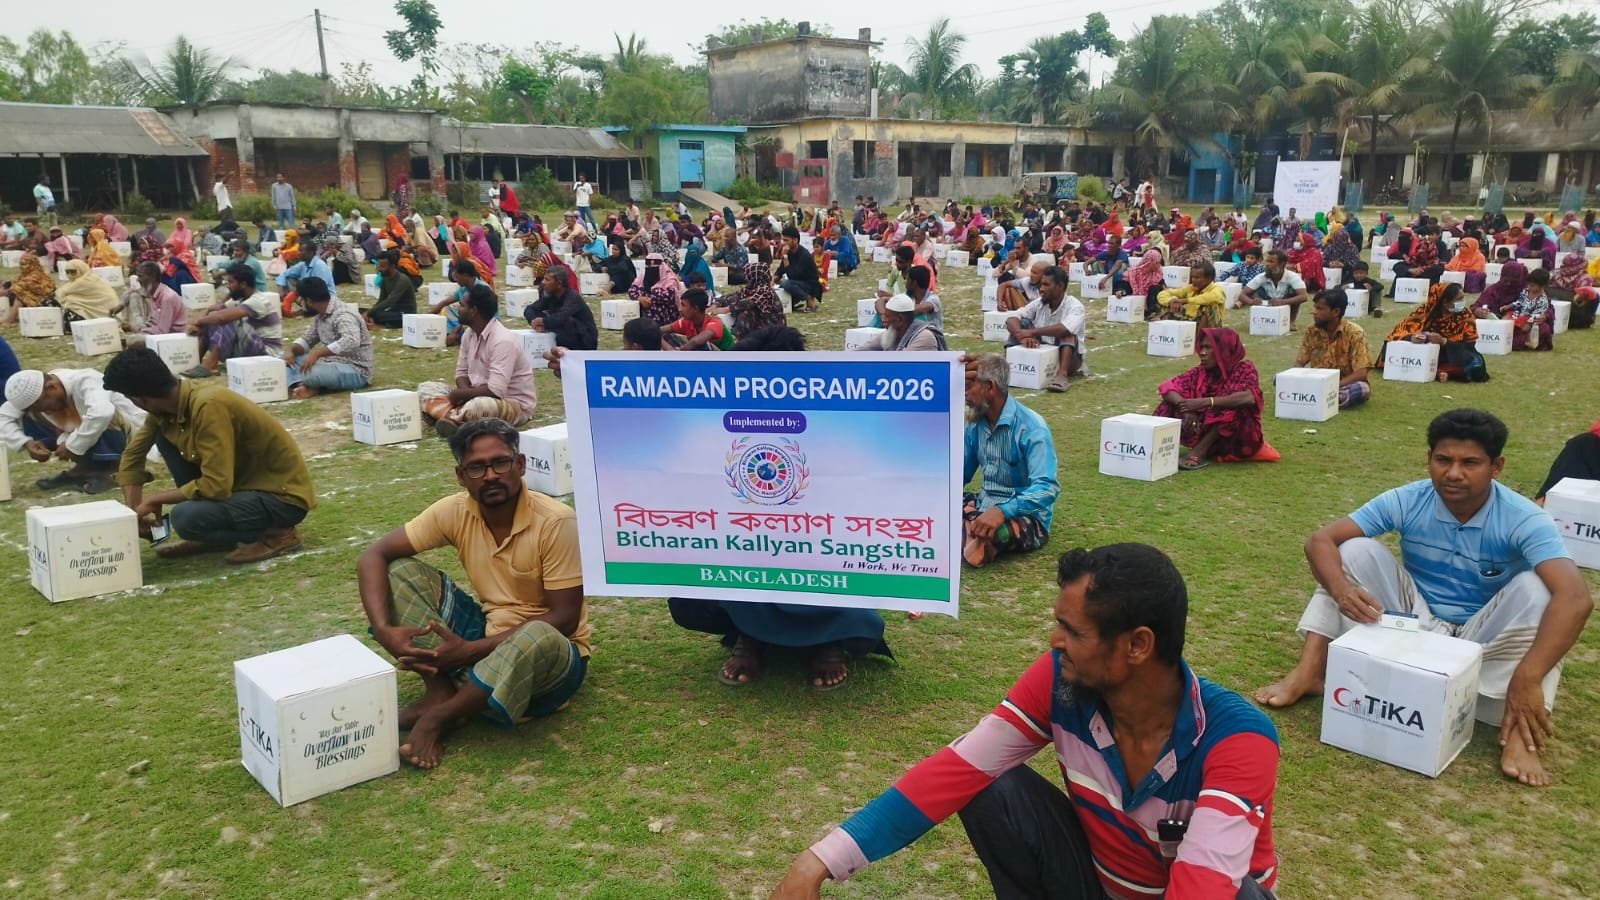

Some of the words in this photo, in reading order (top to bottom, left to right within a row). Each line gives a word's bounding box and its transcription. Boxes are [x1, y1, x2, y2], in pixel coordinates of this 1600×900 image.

[601, 376, 725, 399] RAMADAN
[735, 377, 934, 401] PROGRAM-2026
[729, 416, 784, 428] Implemented
[786, 417, 800, 430] by:
[614, 503, 718, 531] বিচরণ
[728, 511, 835, 536] কল্যাণ
[844, 516, 934, 544] সংস্থা
[1573, 522, 1600, 540] TiK
[617, 531, 718, 550] Bicharan
[725, 534, 812, 559] Kallyan
[821, 538, 935, 563] Sangstha
[700, 568, 848, 588] BANGLADESH
[843, 560, 854, 569] In
[857, 561, 888, 572] Work,
[891, 563, 908, 573] We
[911, 564, 939, 574] Trust
[304, 733, 352, 758] Overflow
[353, 724, 375, 742] with
[315, 743, 367, 770] Blessings
